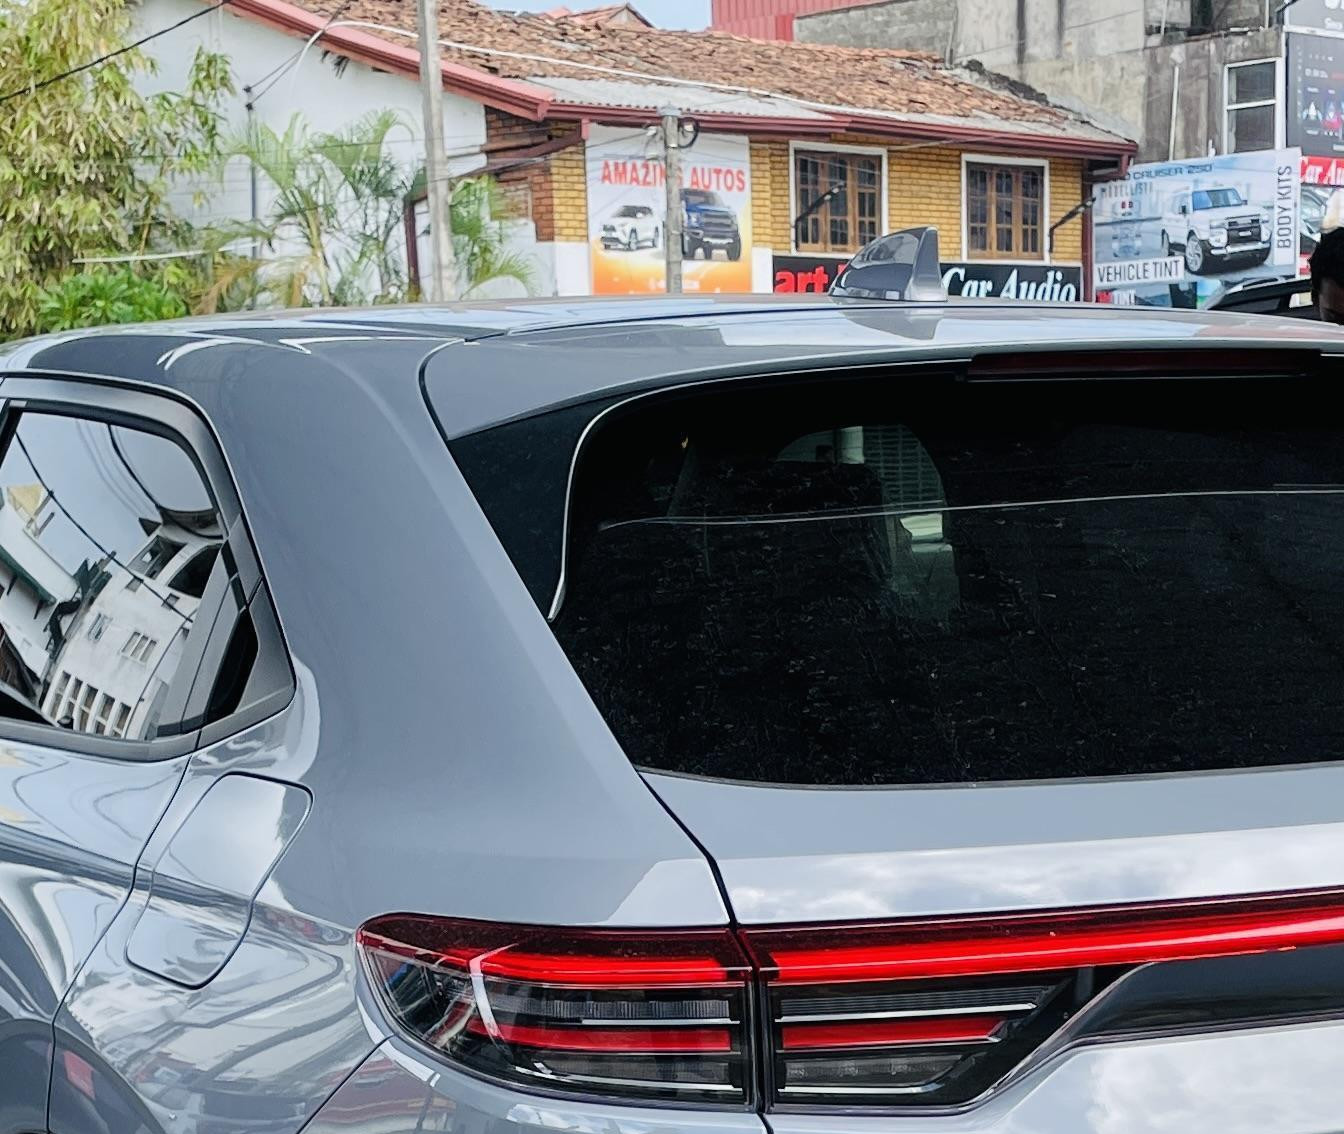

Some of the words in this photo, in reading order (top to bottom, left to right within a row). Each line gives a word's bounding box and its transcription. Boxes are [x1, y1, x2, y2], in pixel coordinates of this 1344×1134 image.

[690, 166, 746, 192] AUTOS
[1277, 165, 1293, 200] KITS
[1299, 156, 1324, 184] Car
[1277, 205, 1292, 249] BODY
[942, 266, 992, 299] Car
[1002, 268, 1077, 302] Audio
[1098, 262, 1150, 283] VEHICLE
[1153, 260, 1181, 278] TINT
